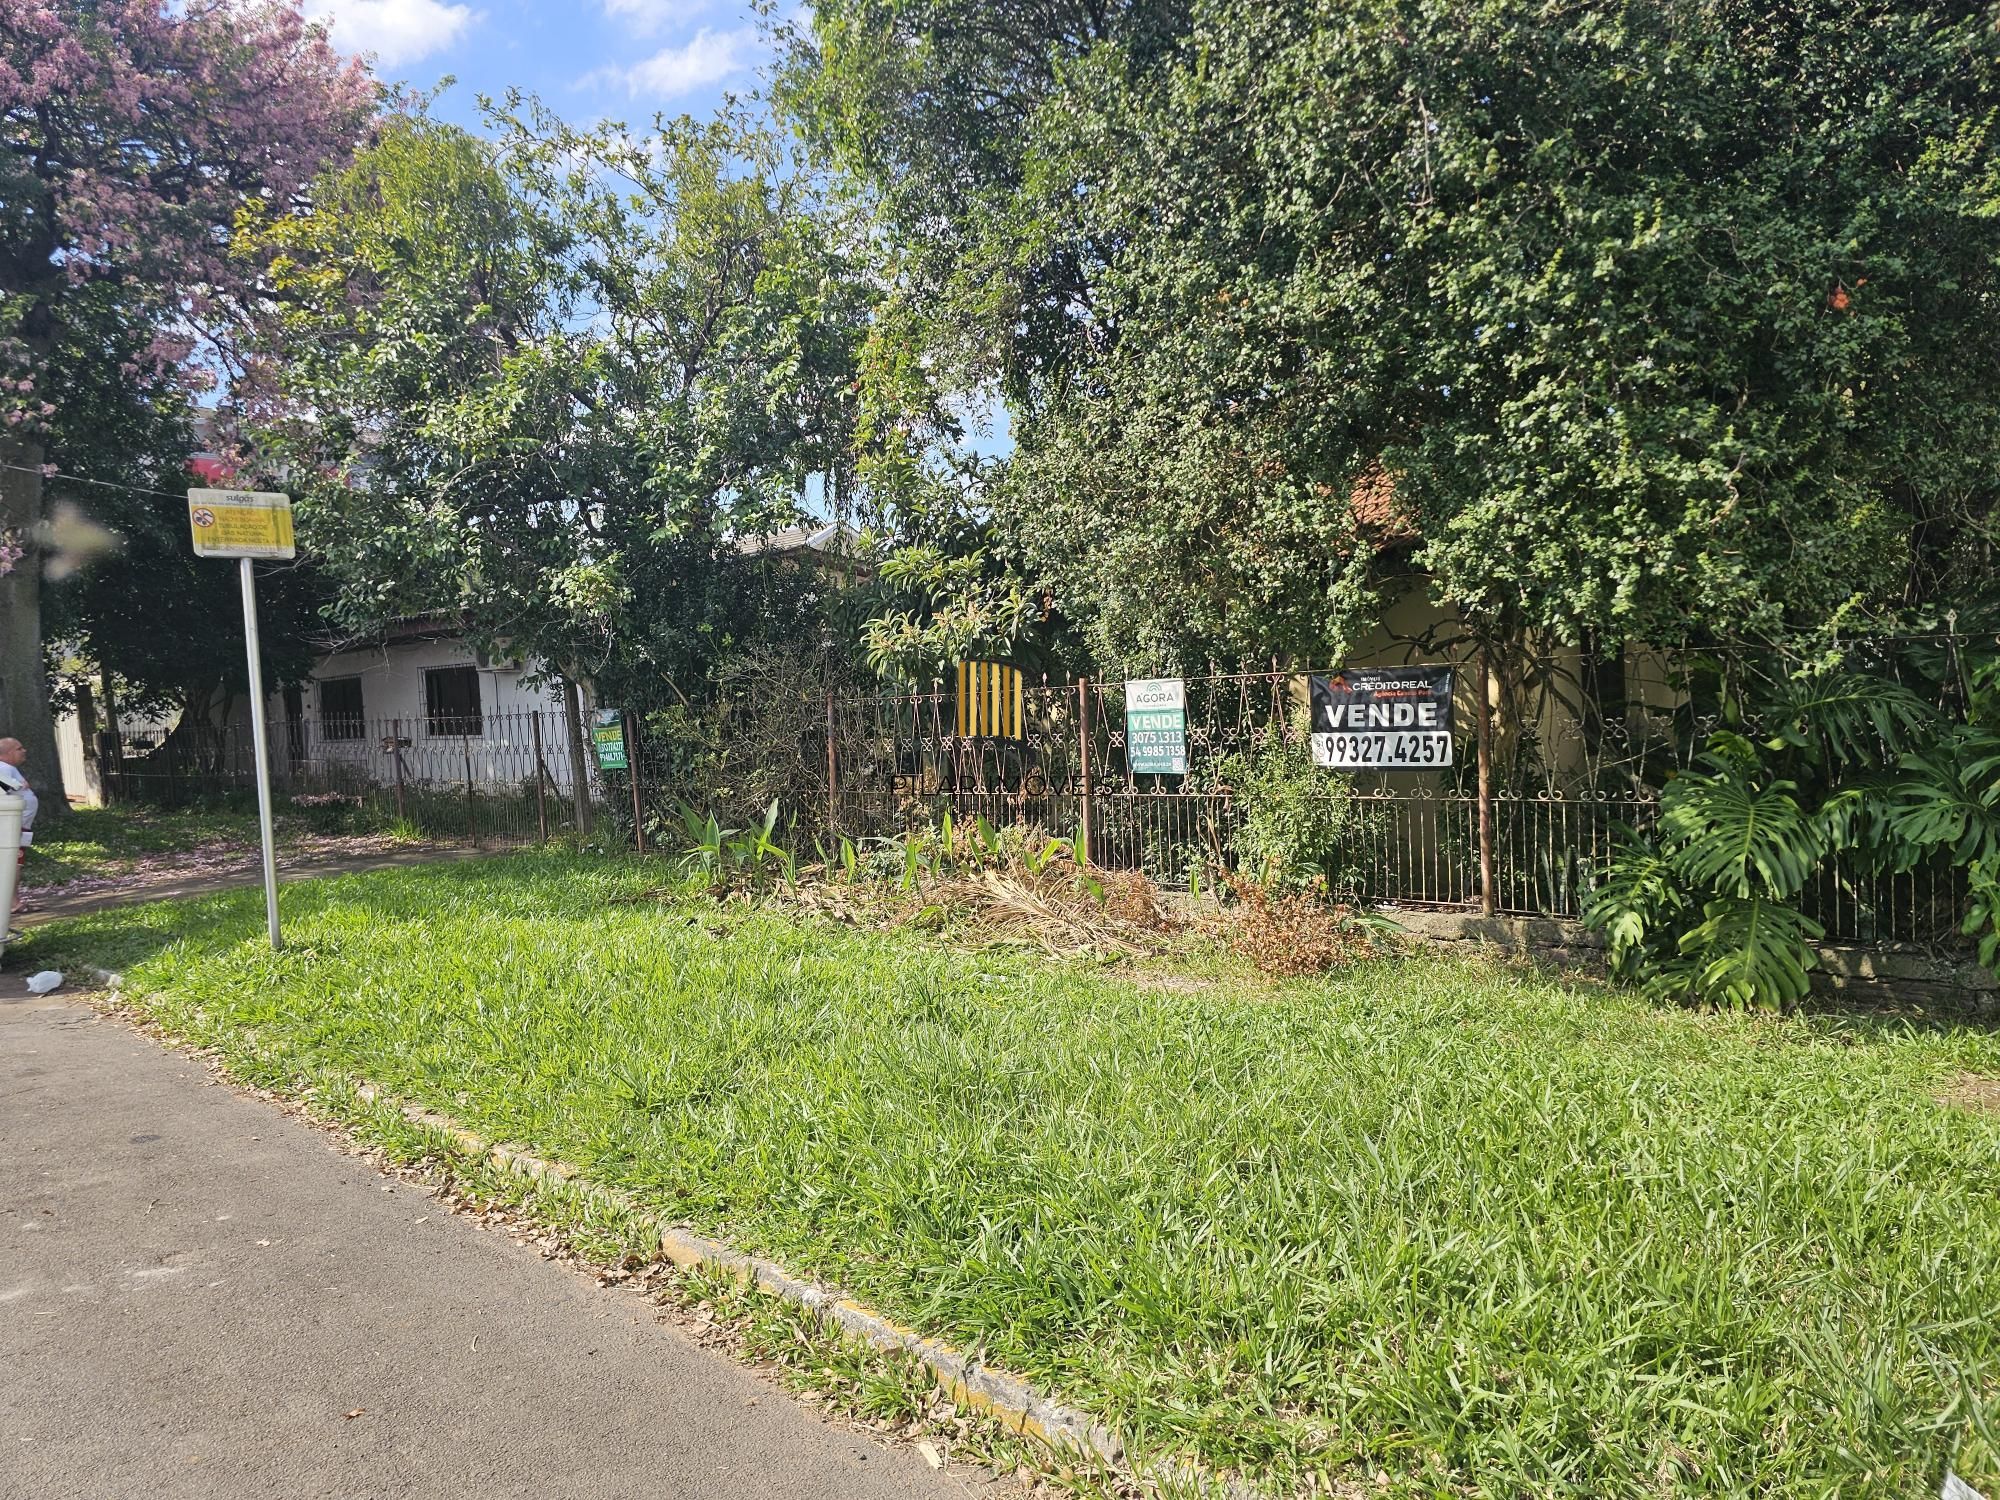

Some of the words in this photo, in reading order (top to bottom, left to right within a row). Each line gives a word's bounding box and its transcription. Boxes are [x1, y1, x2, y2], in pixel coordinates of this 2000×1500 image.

[1352, 680, 1400, 691] CRÉDITO
[1401, 680, 1432, 689] REAL
[1131, 714, 1181, 731] VENDE
[1325, 702, 1438, 728] VENDE
[595, 730, 622, 742] VENDE
[1131, 731, 1157, 744] 3075
[1158, 731, 1182, 743] 1313
[1325, 735, 1450, 763] 99327.4257
